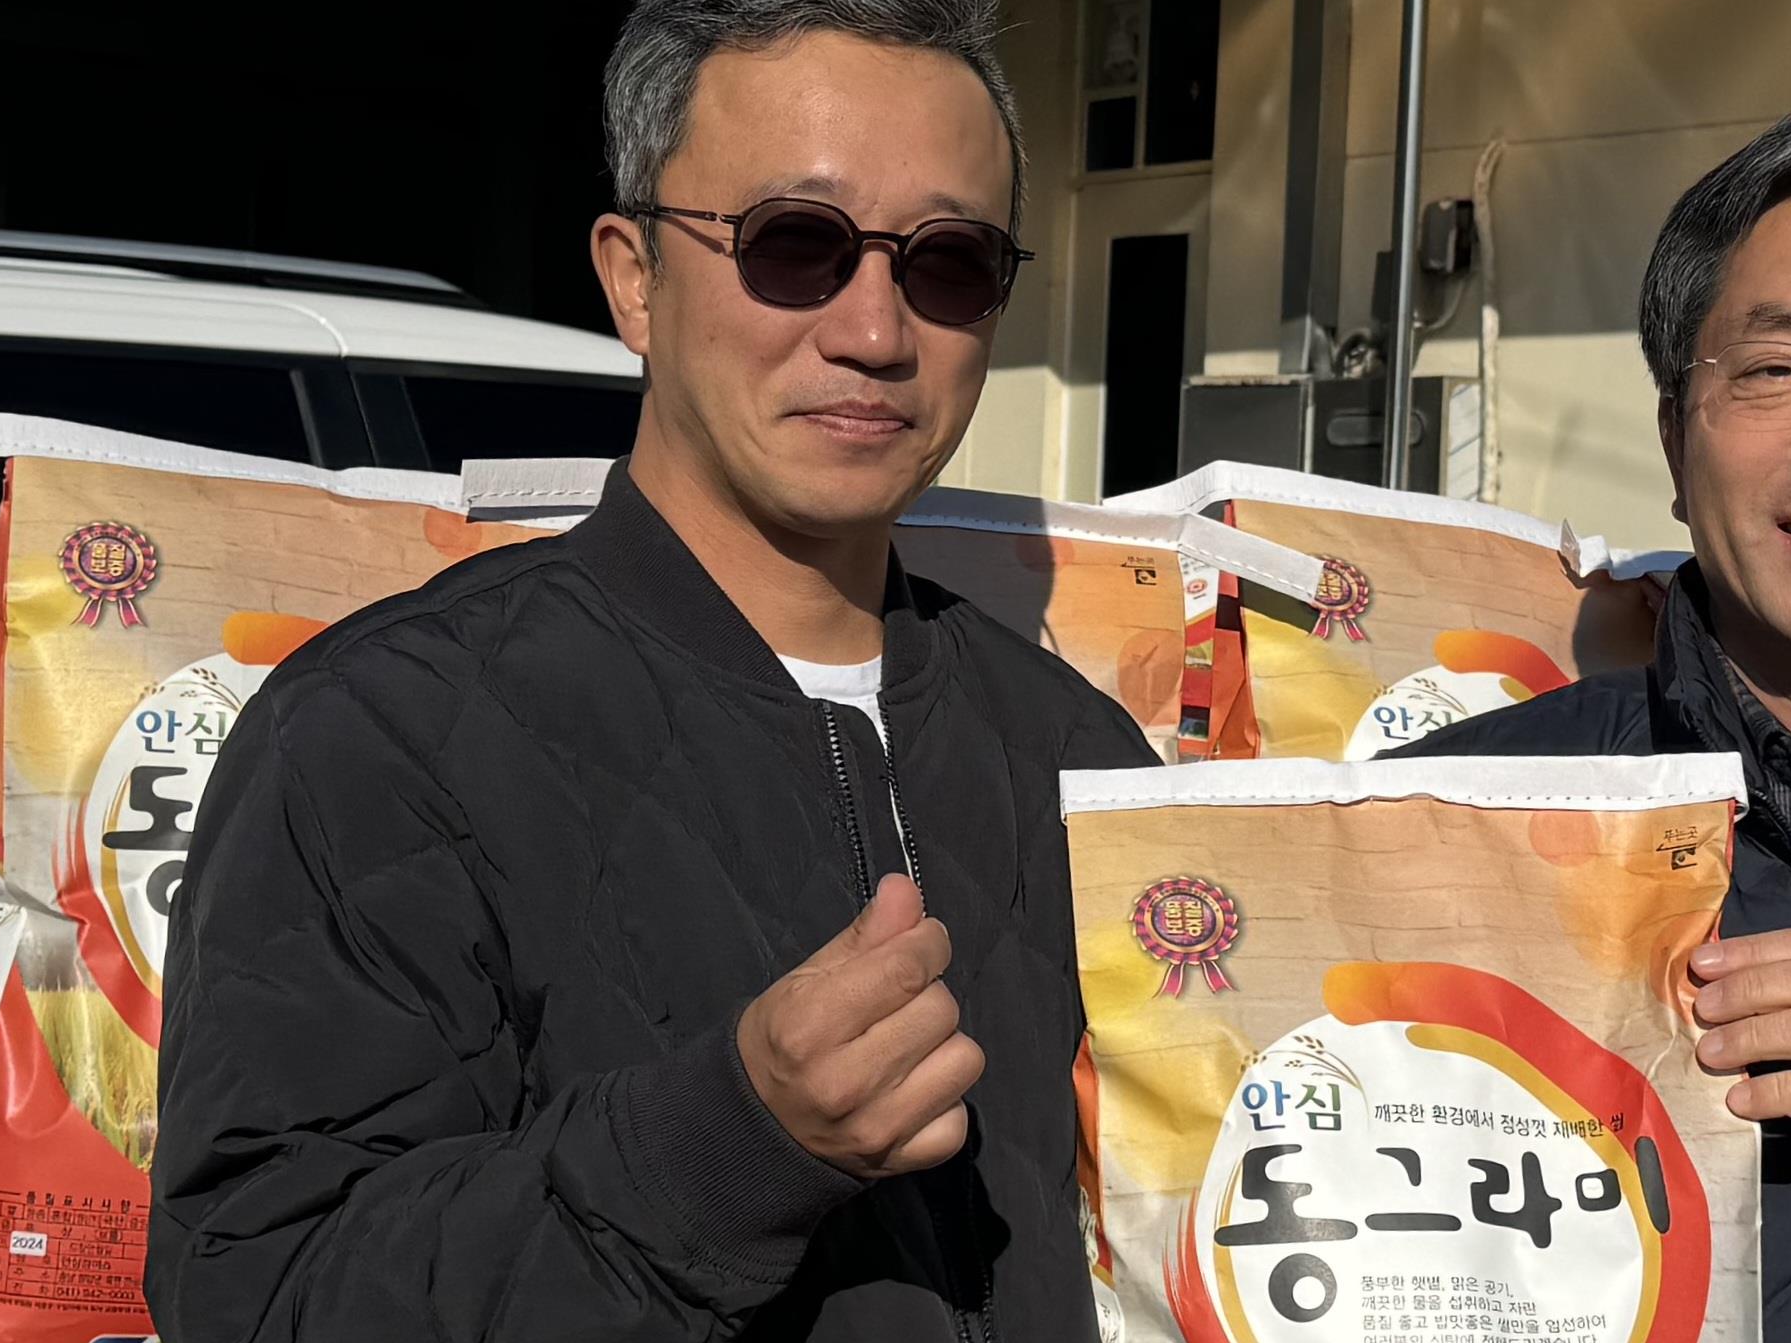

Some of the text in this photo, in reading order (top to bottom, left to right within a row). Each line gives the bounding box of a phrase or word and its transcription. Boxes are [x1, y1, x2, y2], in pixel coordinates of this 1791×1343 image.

[136, 709, 228, 755] 안심
[1241, 1080, 1343, 1133] 안심
[1375, 1104, 1425, 1123] 깨끗한
[1432, 1105, 1495, 1130] 환경에서
[1500, 1114, 1547, 1138] 정성껏
[1553, 1119, 1604, 1139] 재배한
[12, 1235, 44, 1251] 2024
[1214, 1135, 1671, 1323] 동그라미
[1361, 1275, 1405, 1292] 풍부한
[1451, 1276, 1479, 1292] 맑은
[1485, 1280, 1514, 1298] 공기,
[1362, 1295, 1406, 1311] 깨끗한
[1448, 1296, 1503, 1313] 섭취하고
[1363, 1315, 1392, 1331] 품질
[1399, 1315, 1428, 1330] 좋고
